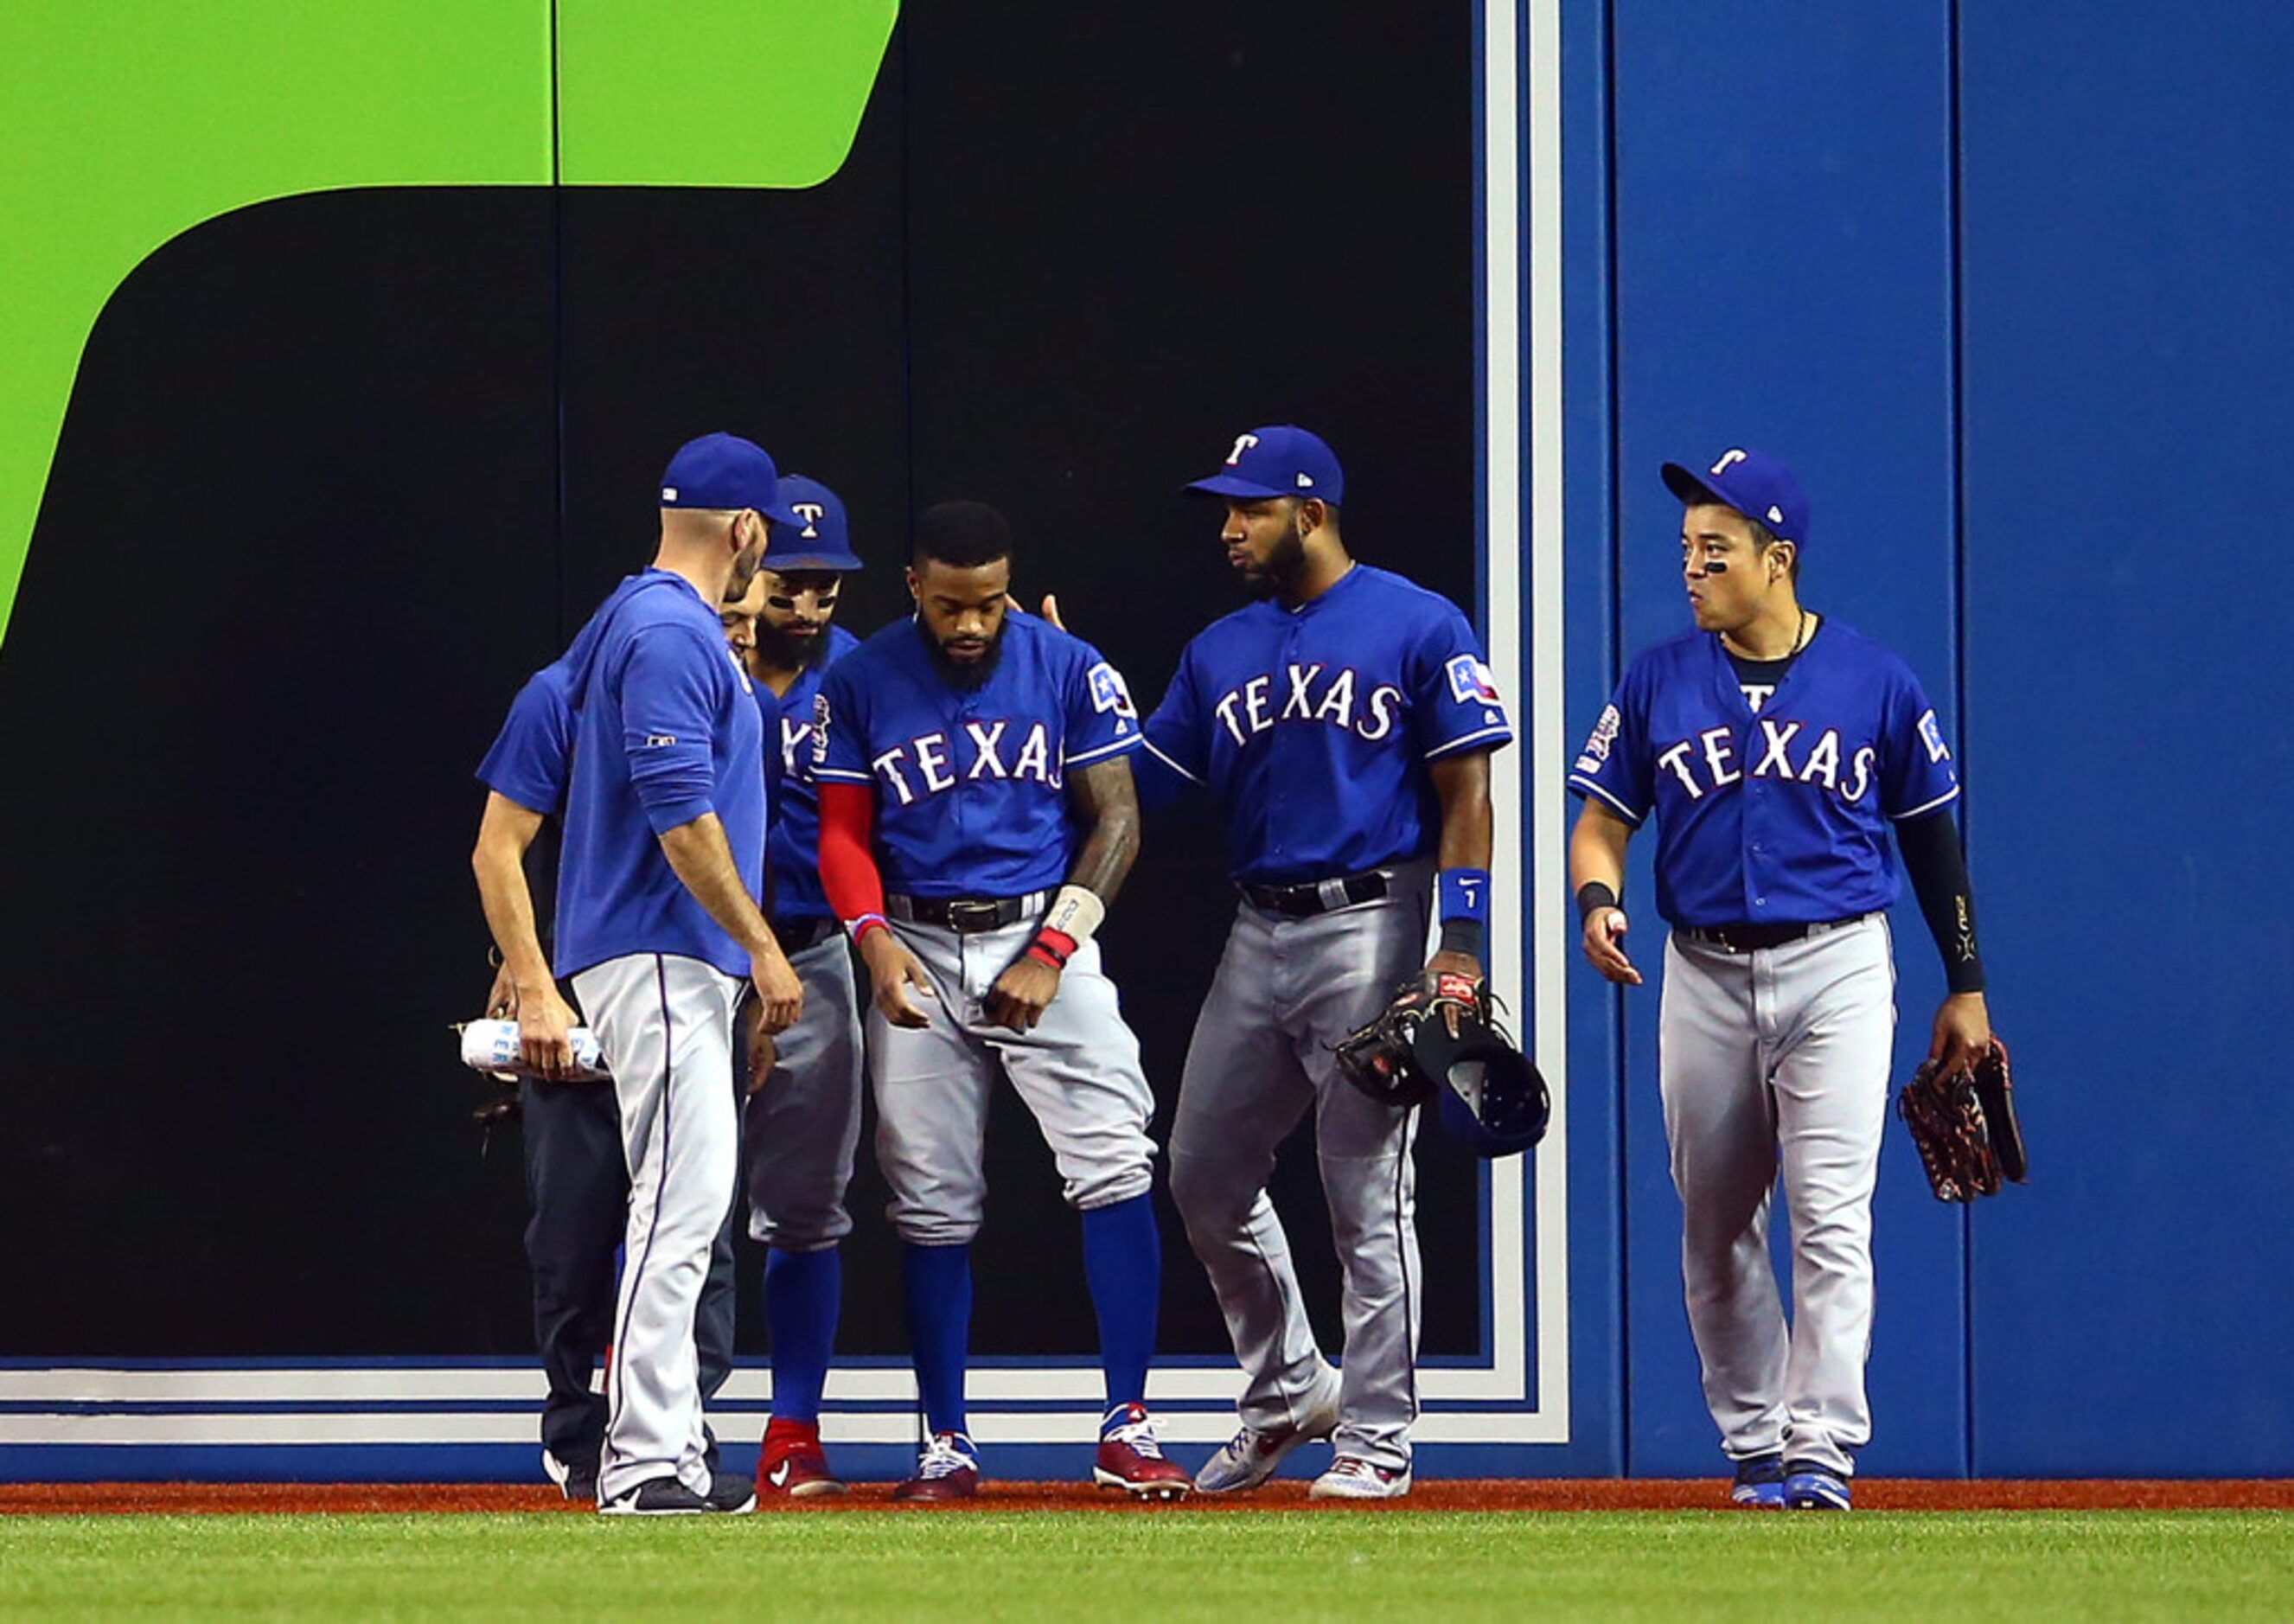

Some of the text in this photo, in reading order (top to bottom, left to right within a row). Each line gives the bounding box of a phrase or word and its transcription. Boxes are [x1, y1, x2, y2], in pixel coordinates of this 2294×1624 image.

[1225, 433, 1258, 465] T
[791, 503, 823, 538] T
[1215, 663, 1402, 747] TEXAS
[1658, 719, 1876, 802] TEXAS
